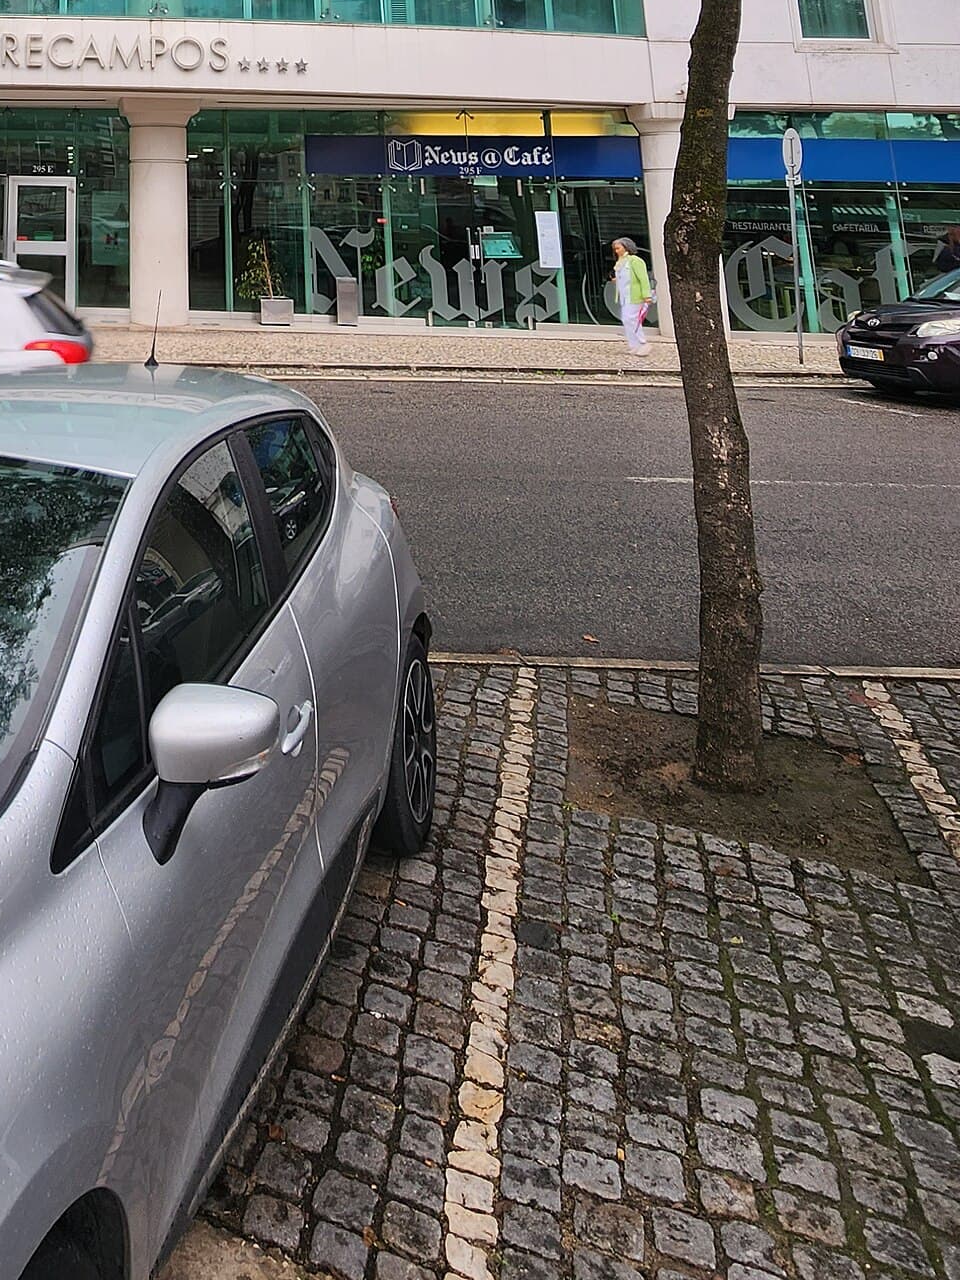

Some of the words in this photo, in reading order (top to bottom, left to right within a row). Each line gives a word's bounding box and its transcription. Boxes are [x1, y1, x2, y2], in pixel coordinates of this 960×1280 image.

[424, 145, 479, 167] News
[503, 145, 553, 167] Café
[32, 164, 46, 174] 295
[47, 164, 54, 174] E
[459, 166, 475, 175] 295
[732, 221, 792, 232] RESTAURANTE
[832, 223, 880, 233] CAFETARIA
[310, 225, 563, 329] News
[725, 235, 944, 333] Caf
